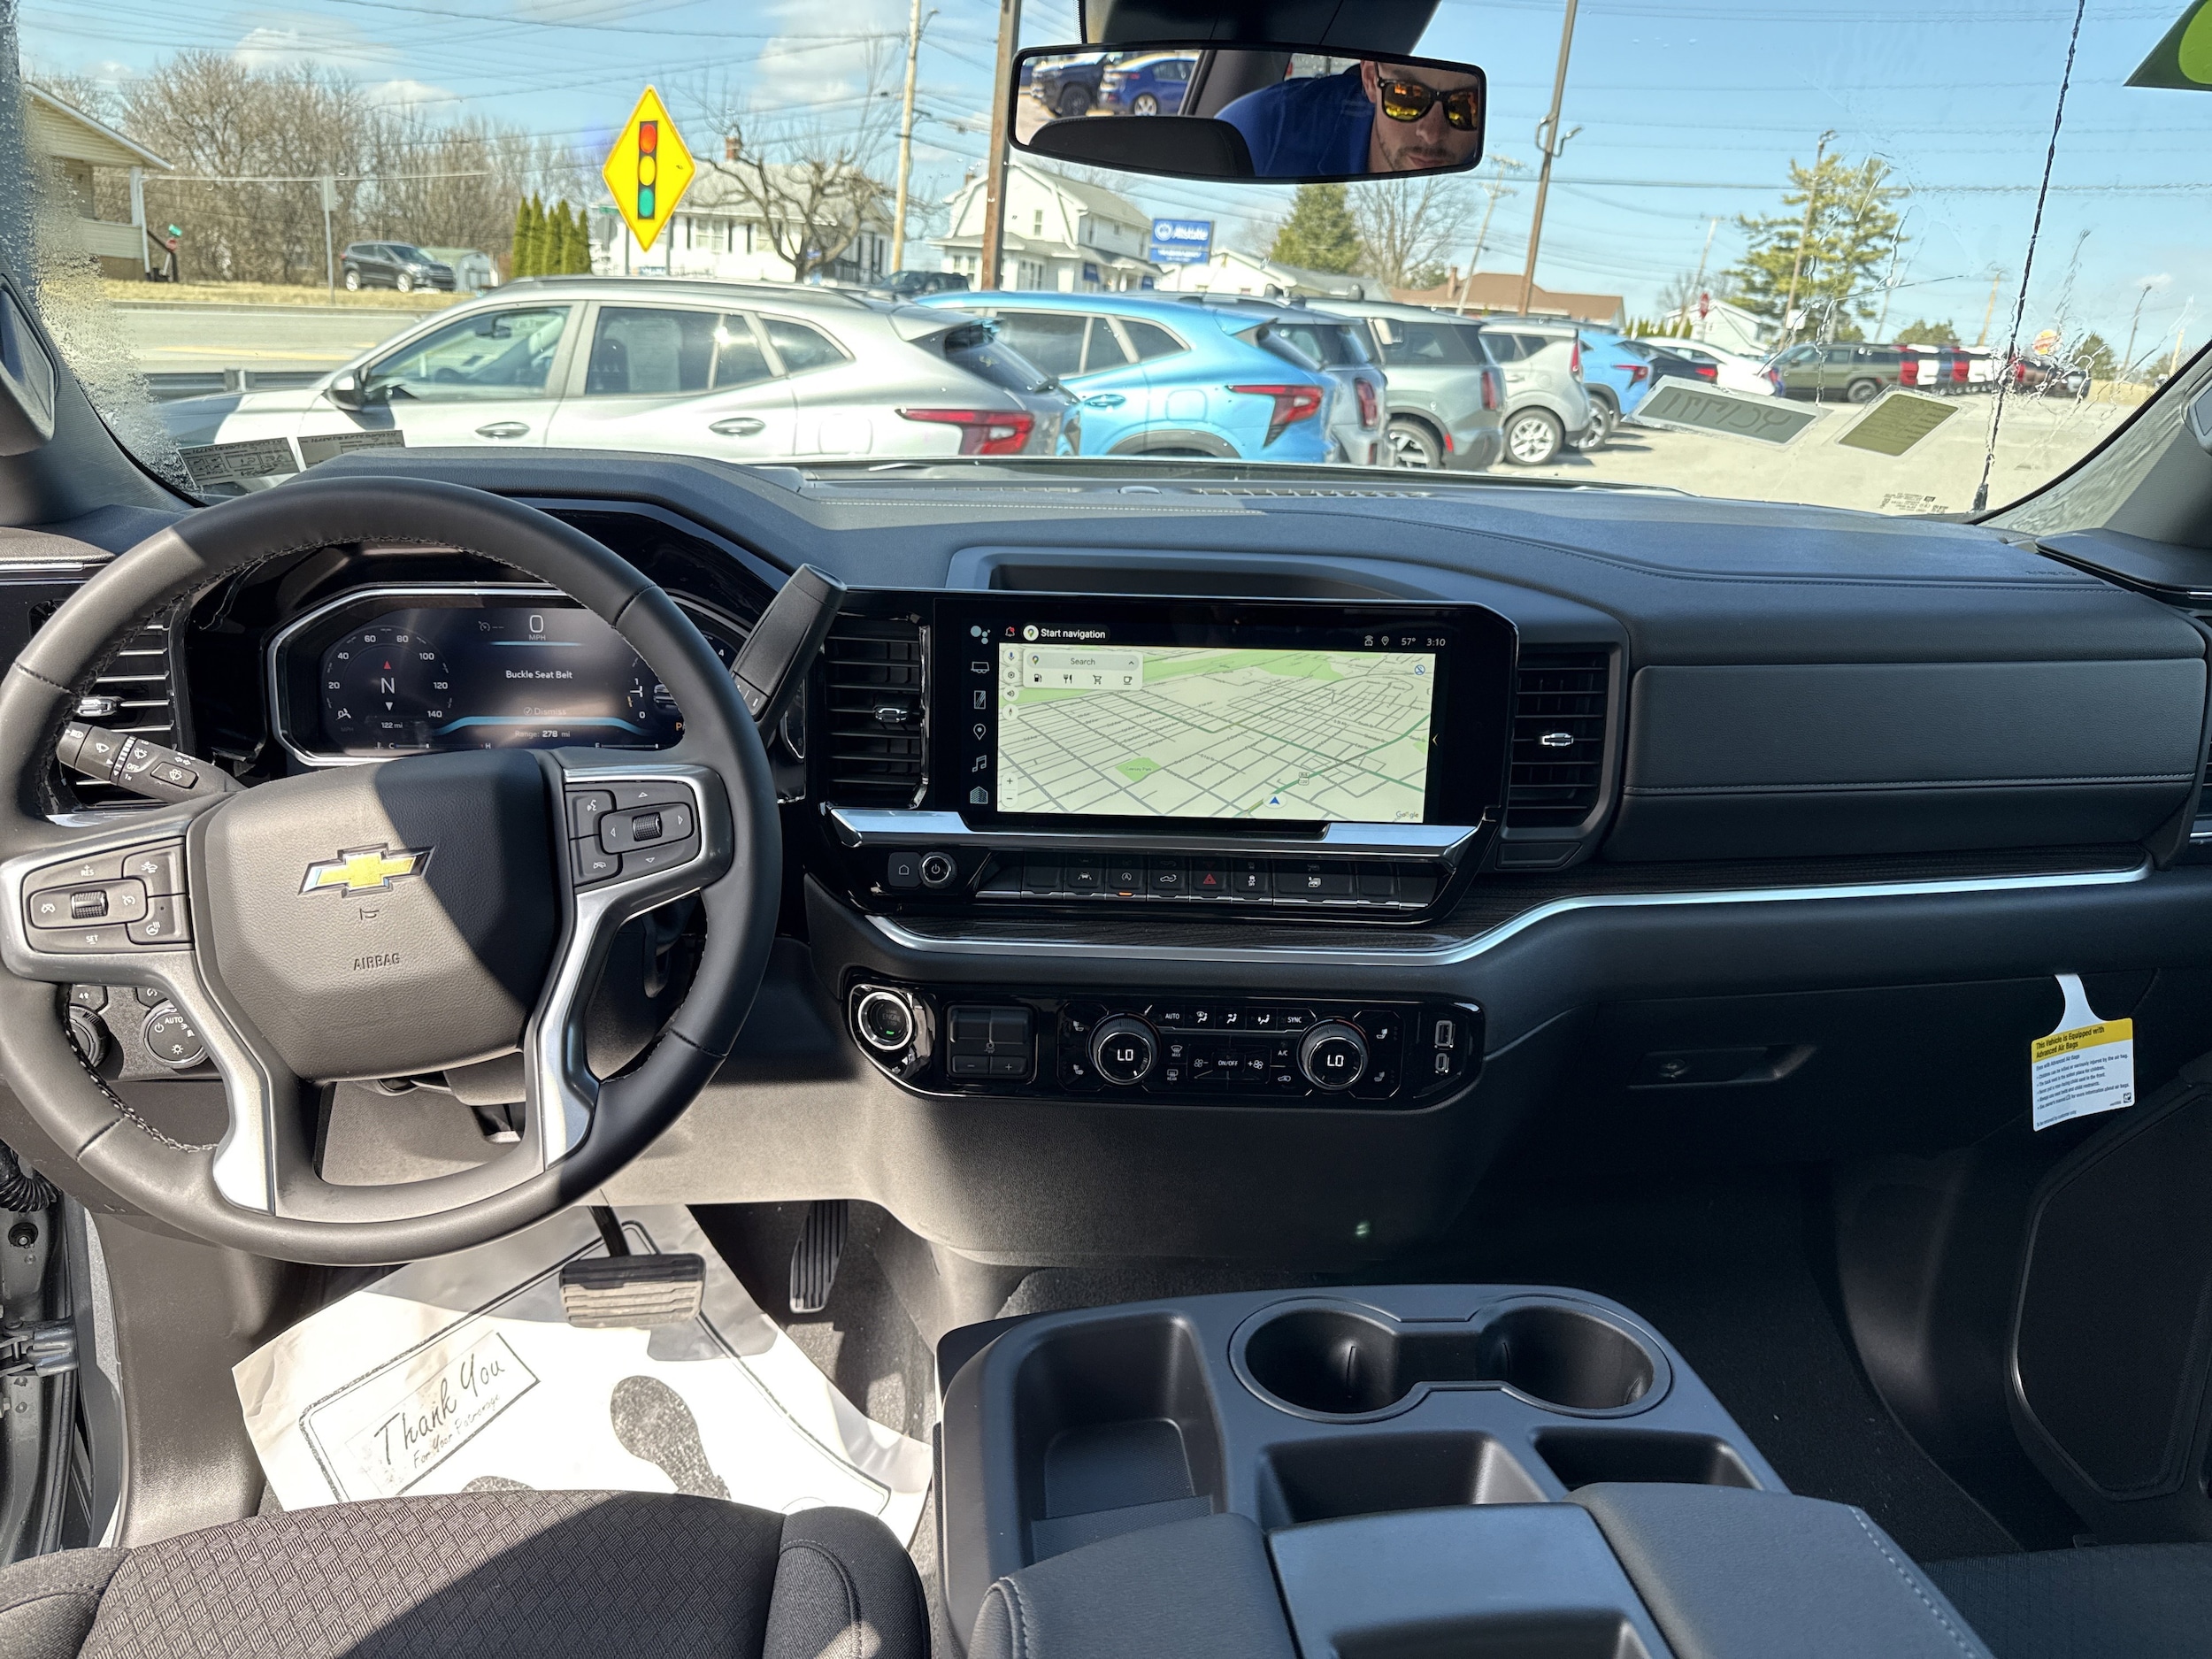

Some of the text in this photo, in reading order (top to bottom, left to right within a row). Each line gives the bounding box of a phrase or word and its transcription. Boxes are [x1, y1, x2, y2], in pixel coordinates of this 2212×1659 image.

[529, 615, 543, 633] 0
[1063, 630, 1105, 639] navigation
[556, 671, 572, 680] Belt
[380, 678, 396, 694] N
[354, 953, 400, 971] AIRBAG
[2046, 1037, 2062, 1047] Vehicle
[2069, 1028, 2092, 1041] Equipped
[1118, 1049, 1133, 1061] LO
[2036, 1048, 2057, 1058] Advanced
[2066, 1041, 2078, 1050] Bags
[1327, 1055, 1344, 1067] LO
[373, 1354, 505, 1465] Thank You
[413, 1394, 500, 1469] For Your Patronage
